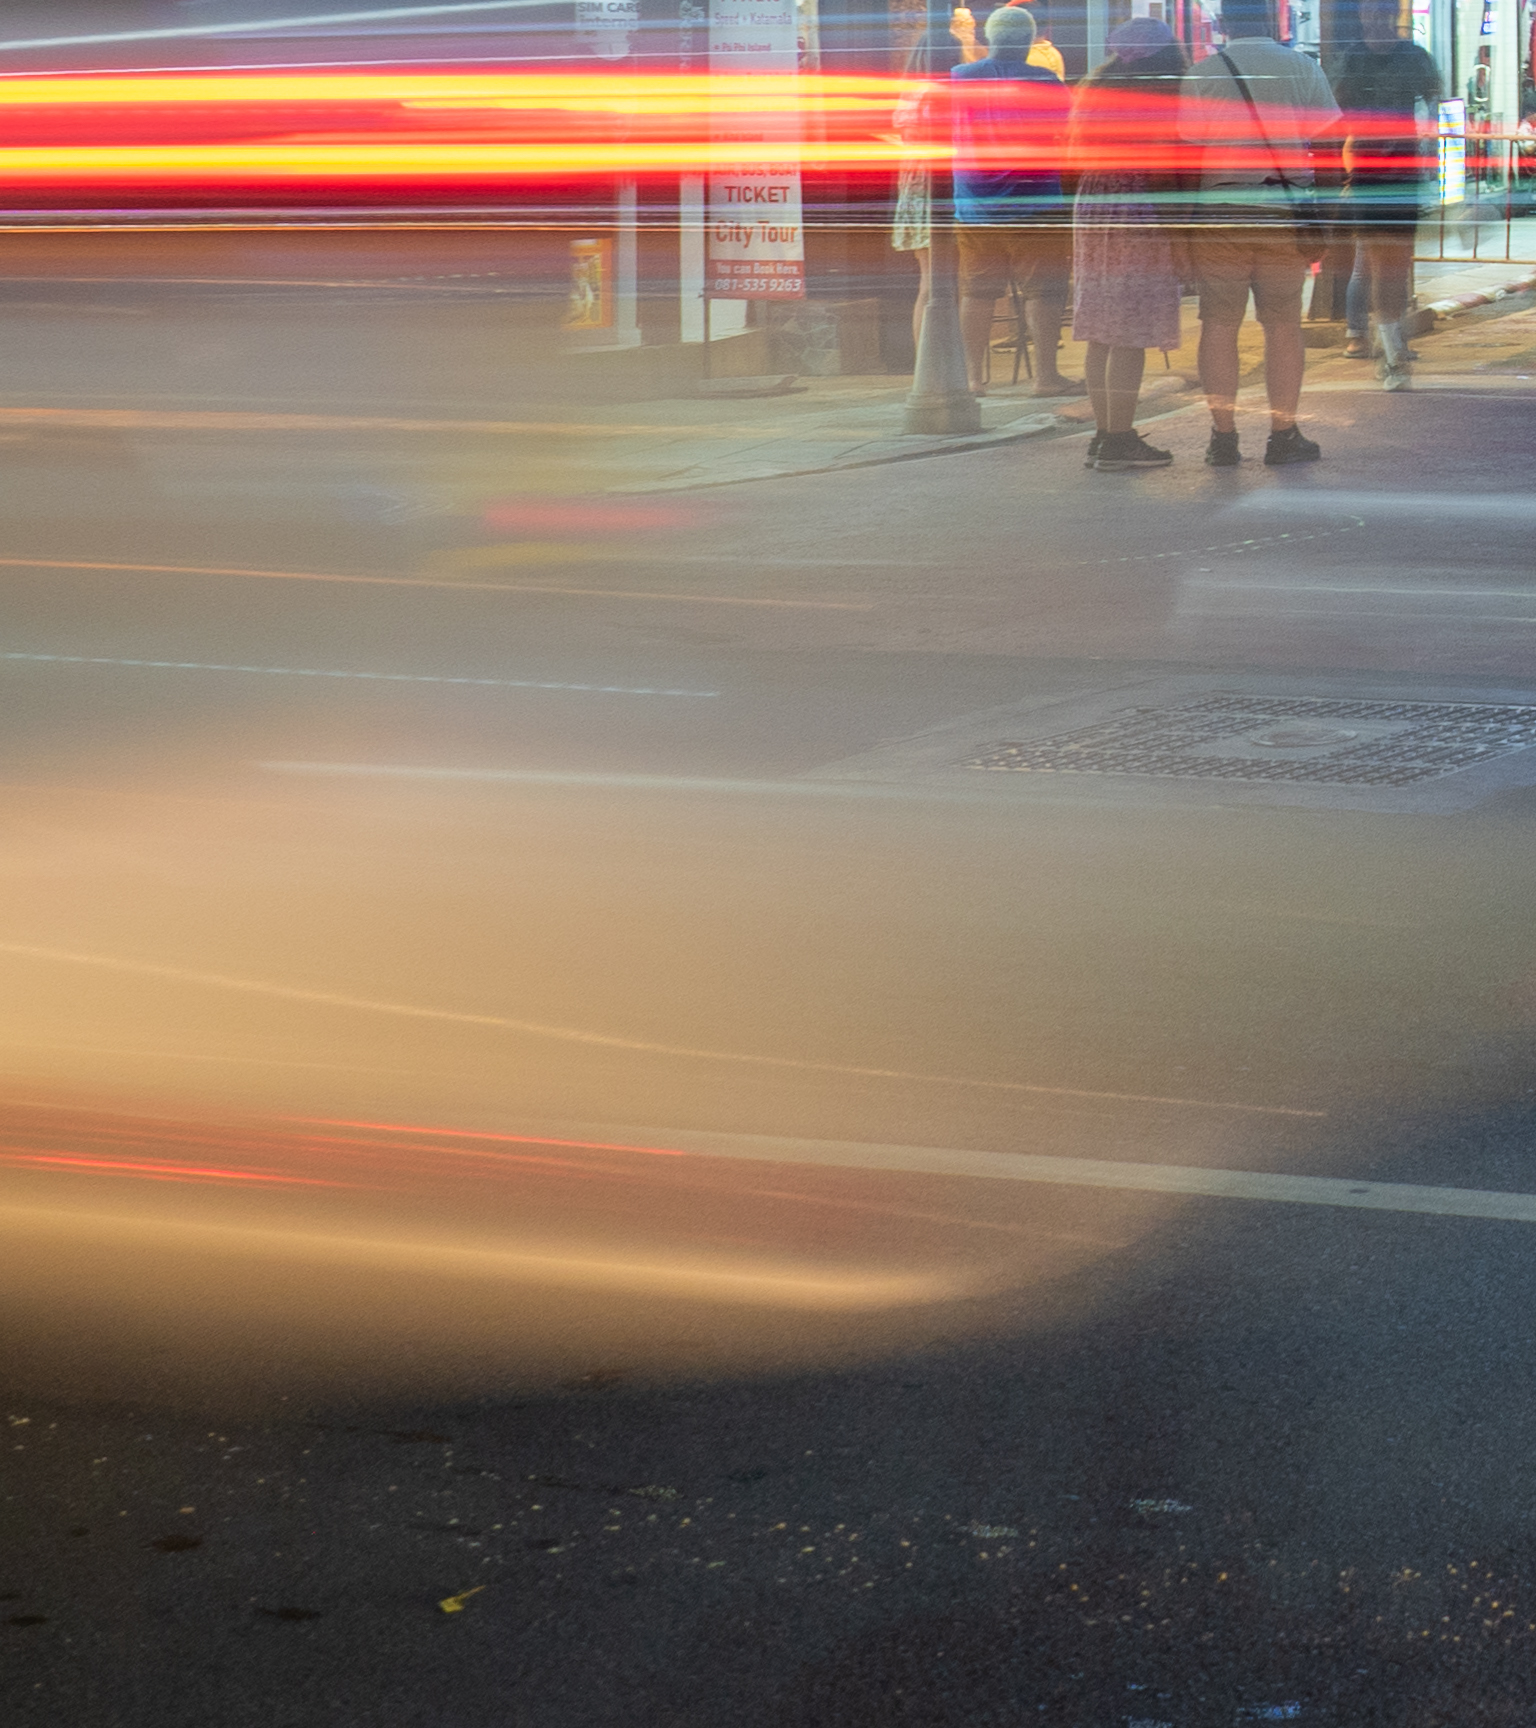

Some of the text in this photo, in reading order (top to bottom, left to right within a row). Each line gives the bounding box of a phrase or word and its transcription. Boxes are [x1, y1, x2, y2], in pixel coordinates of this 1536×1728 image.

[724, 186, 790, 203] TICKET
[714, 221, 798, 249] City Tour
[769, 279, 801, 291] 9263
